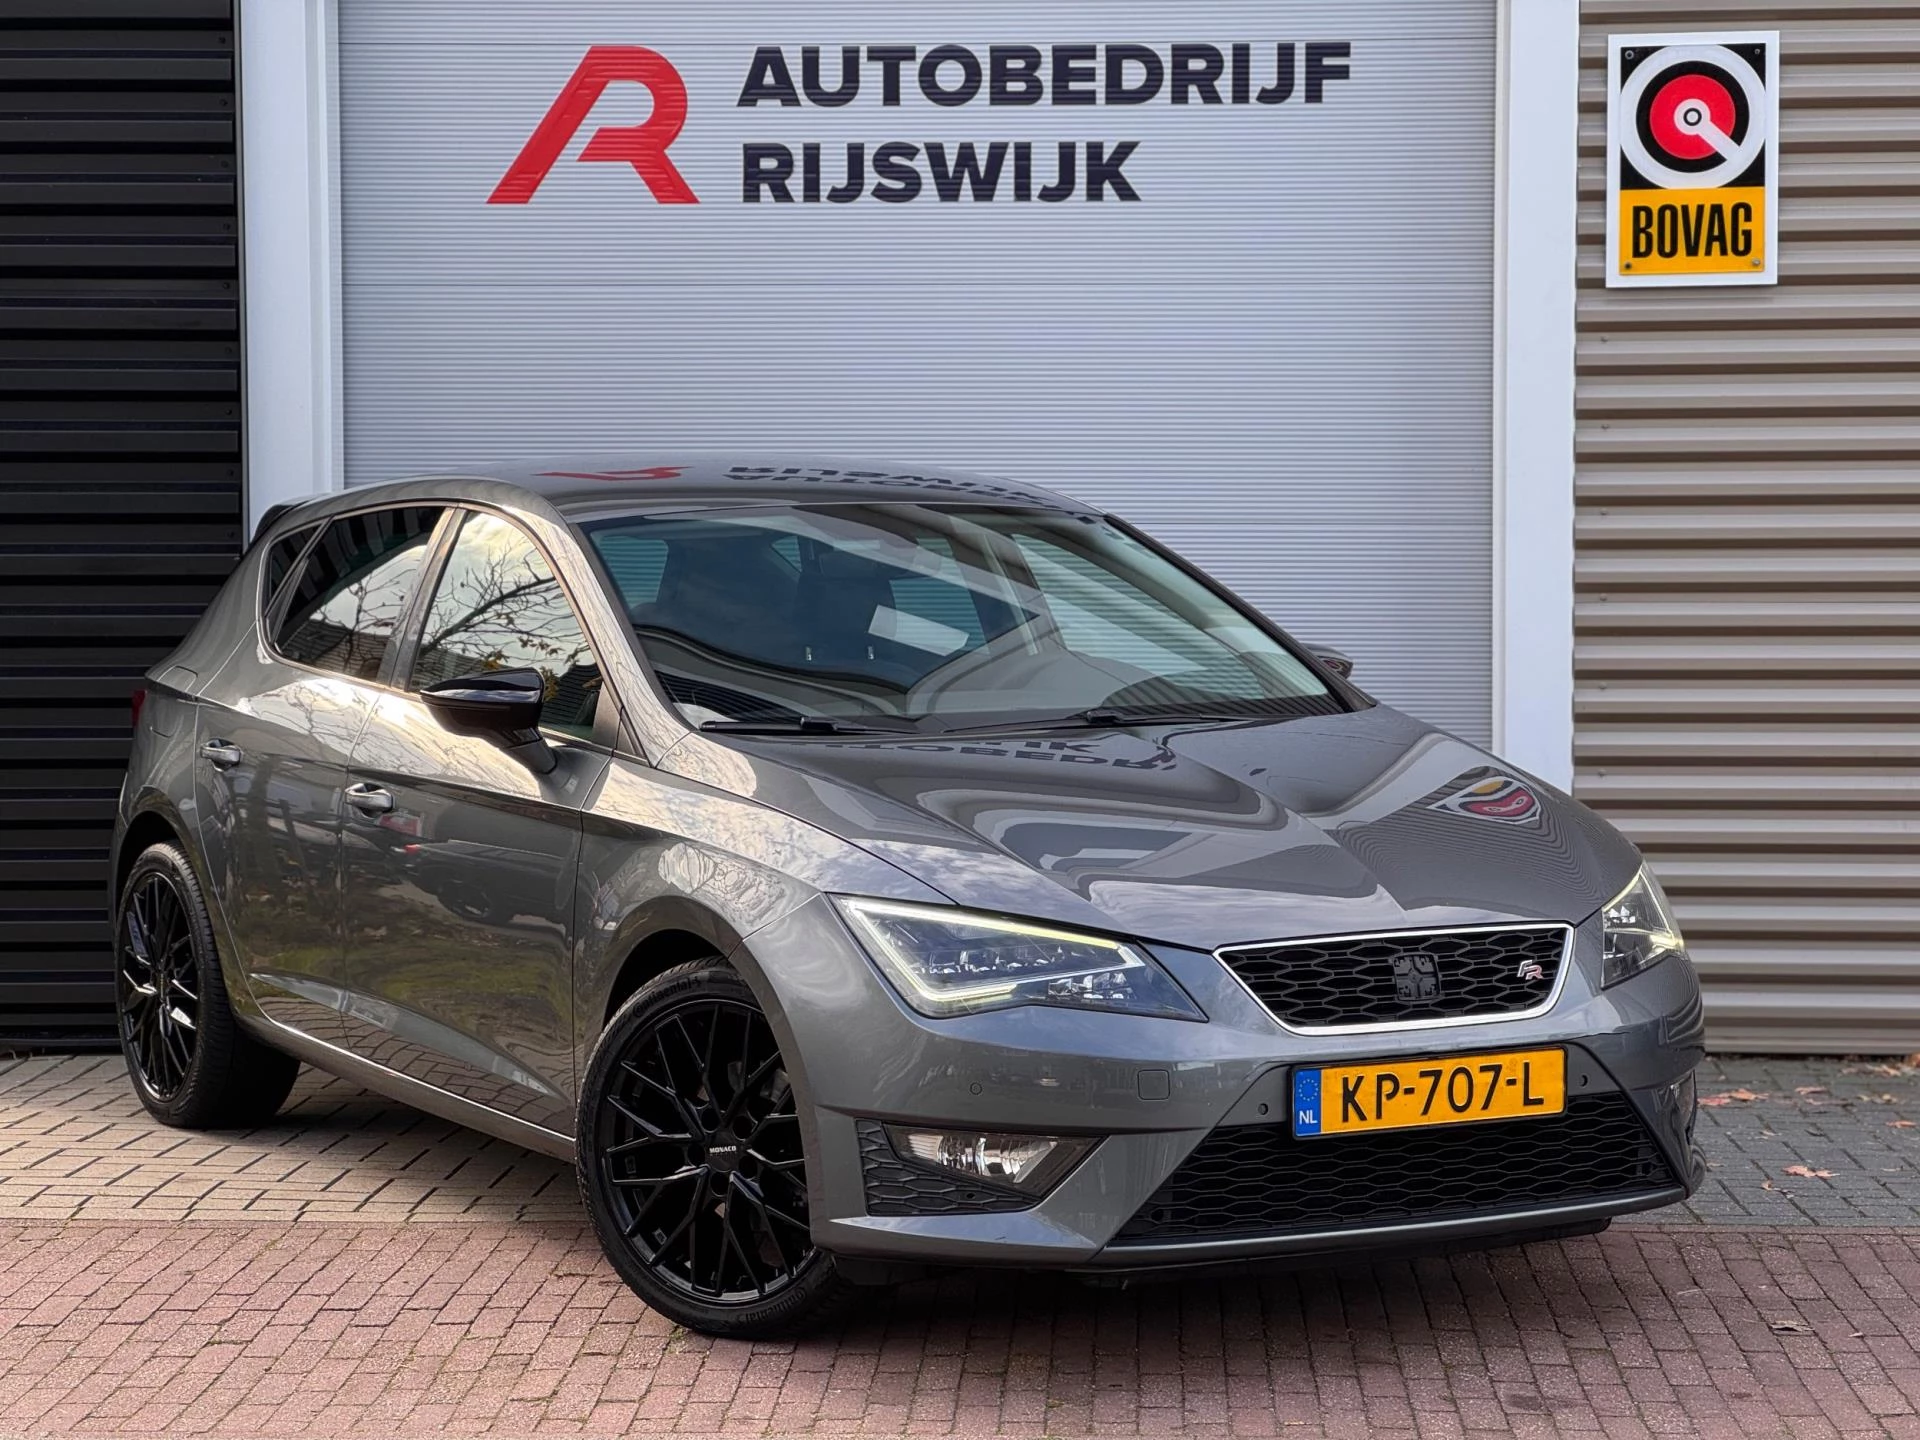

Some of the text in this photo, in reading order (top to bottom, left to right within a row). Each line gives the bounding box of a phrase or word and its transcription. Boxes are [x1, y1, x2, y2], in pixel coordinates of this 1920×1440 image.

[737, 42, 1352, 107] AUTOBEDRIJF
[743, 141, 1142, 202] RIJSWIJK
[1632, 202, 1753, 258] BOVAG
[1299, 1110, 1318, 1124] NL
[1341, 1061, 1545, 1123] KP-707-L
[709, 1145, 737, 1154] MONACO
